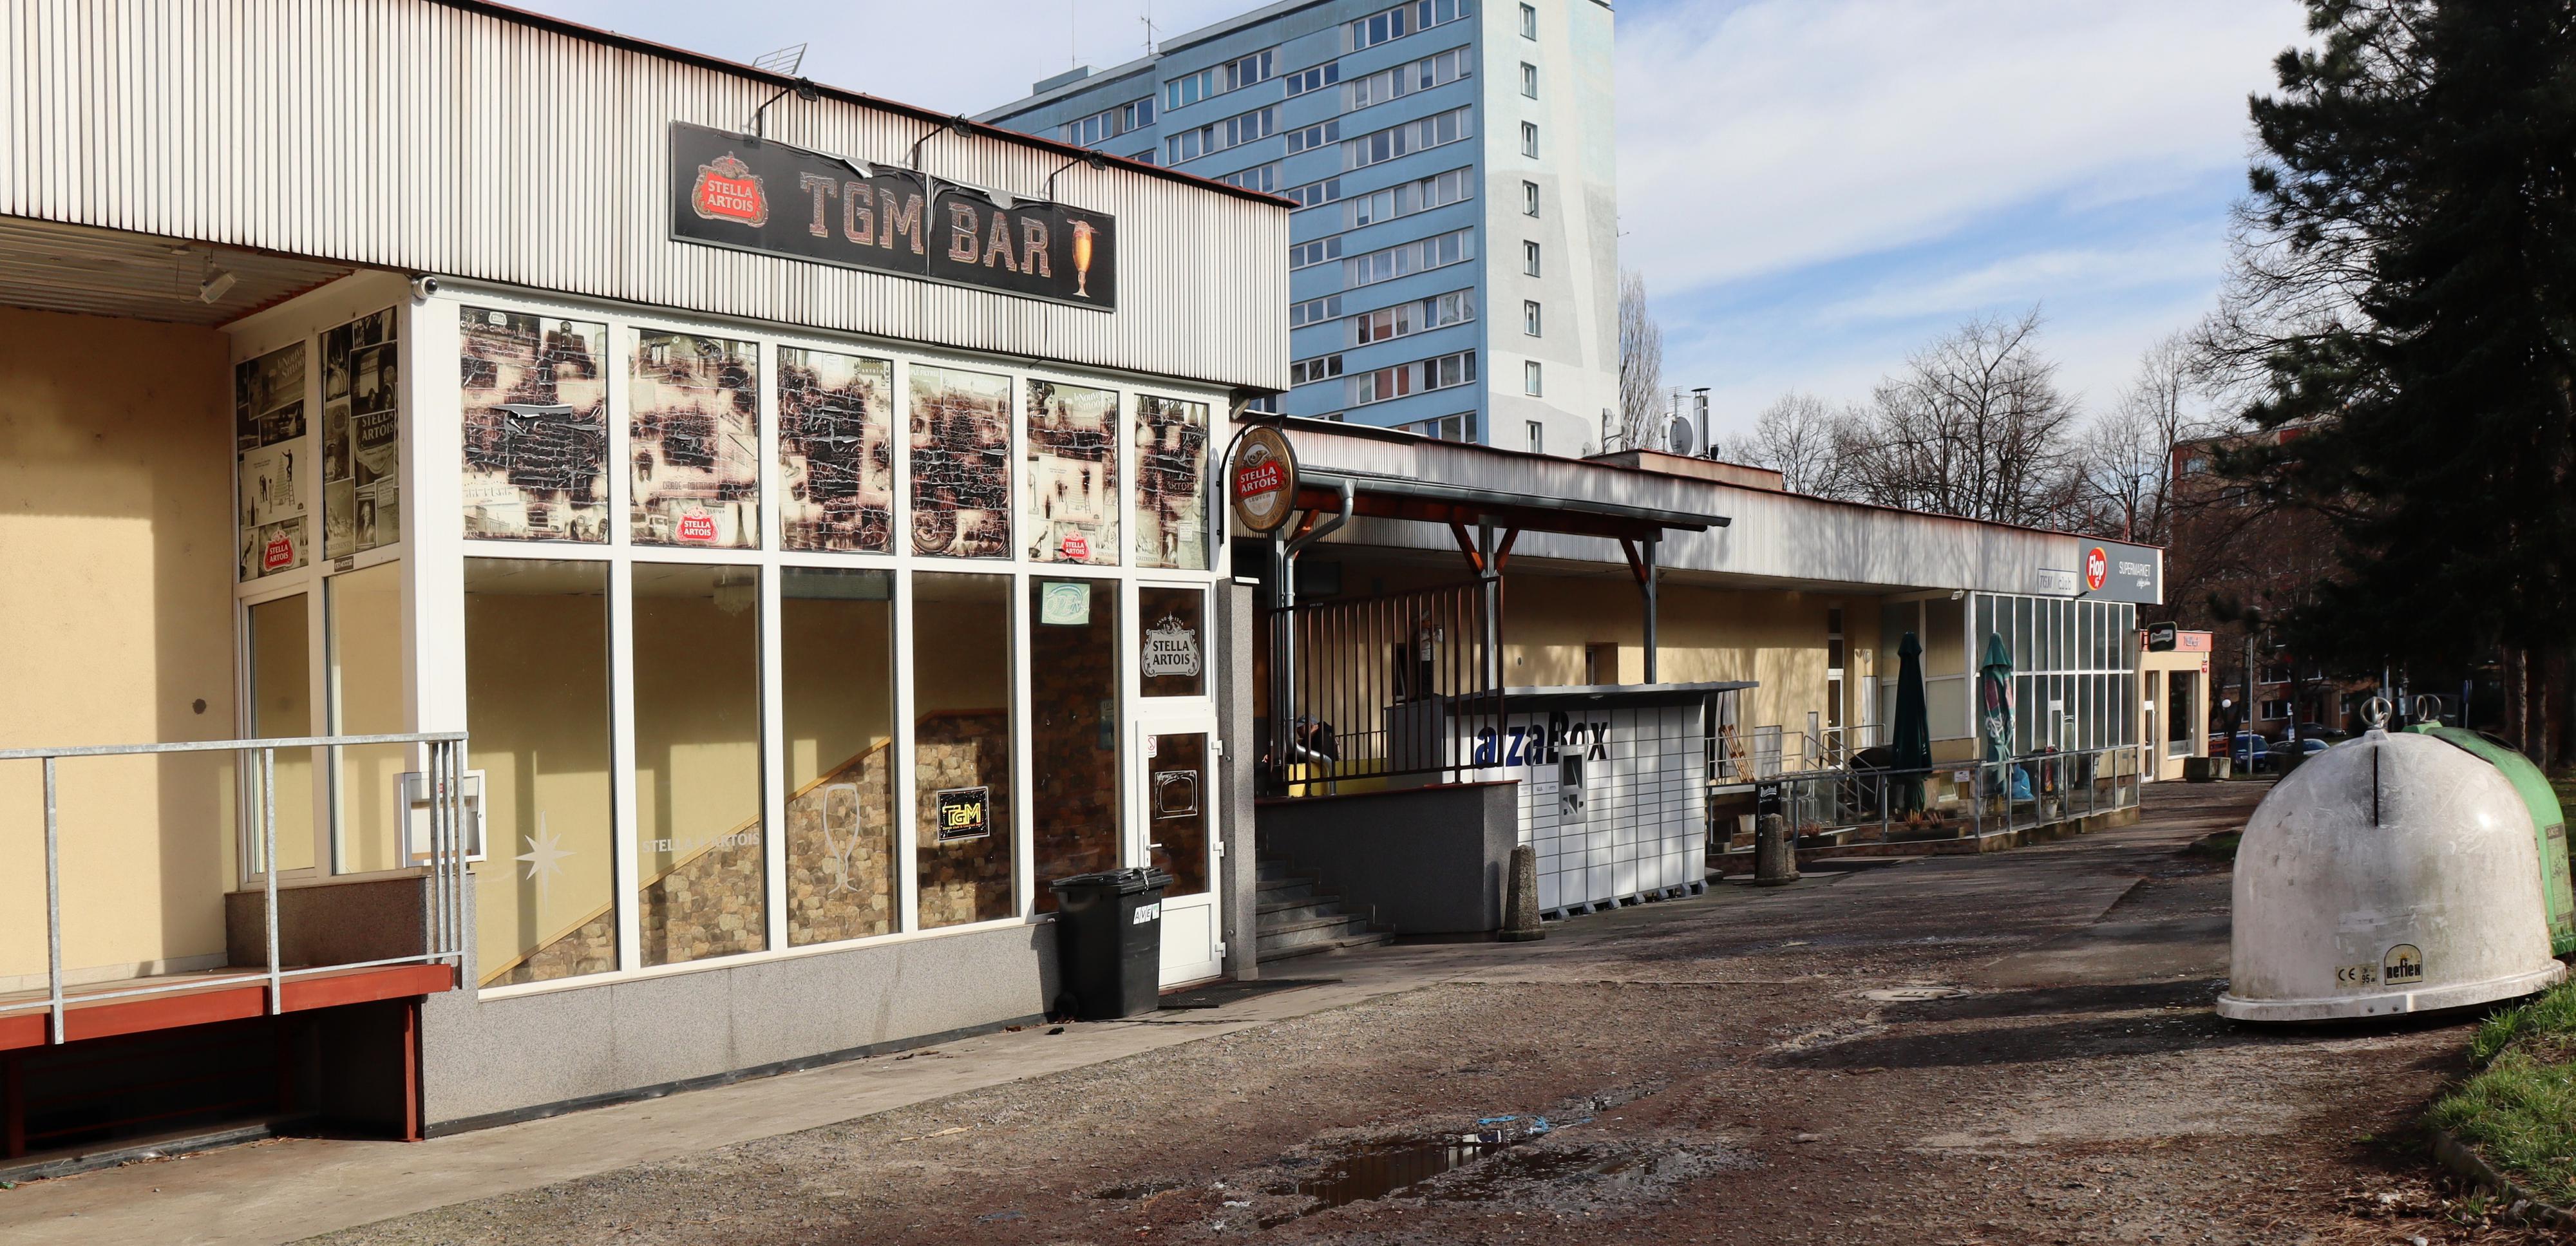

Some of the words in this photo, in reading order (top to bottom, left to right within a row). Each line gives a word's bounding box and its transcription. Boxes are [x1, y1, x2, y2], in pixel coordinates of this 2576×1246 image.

[708, 180, 753, 198] STELLA
[708, 194, 753, 212] ARTOIS
[800, 171, 923, 254] TGM
[949, 202, 1051, 278] BAR
[362, 412, 393, 427] STELLA
[361, 420, 394, 441] ARTOIS
[1240, 466, 1276, 484] STELLA
[1241, 476, 1278, 494] ARTOIS
[684, 520, 711, 529] STELLA
[684, 528, 711, 536] ARTOIS
[269, 544, 288, 555] STELLA
[269, 552, 289, 563] ARTOIS
[2088, 555, 2105, 580] Flop
[2119, 561, 2151, 577] SUPERMARKET
[2040, 575, 2052, 589] TGM
[2058, 578, 2072, 590] club
[1153, 640, 1189, 652] STELLA
[1153, 654, 1190, 665] ARTOIS
[1475, 711, 1608, 766] azaBox
[942, 802, 981, 826] TGM
[643, 839, 694, 853] STELLA
[712, 833, 760, 847] ARTOIS
[1135, 909, 1151, 920] AVE
[2362, 974, 2370, 983] 95
